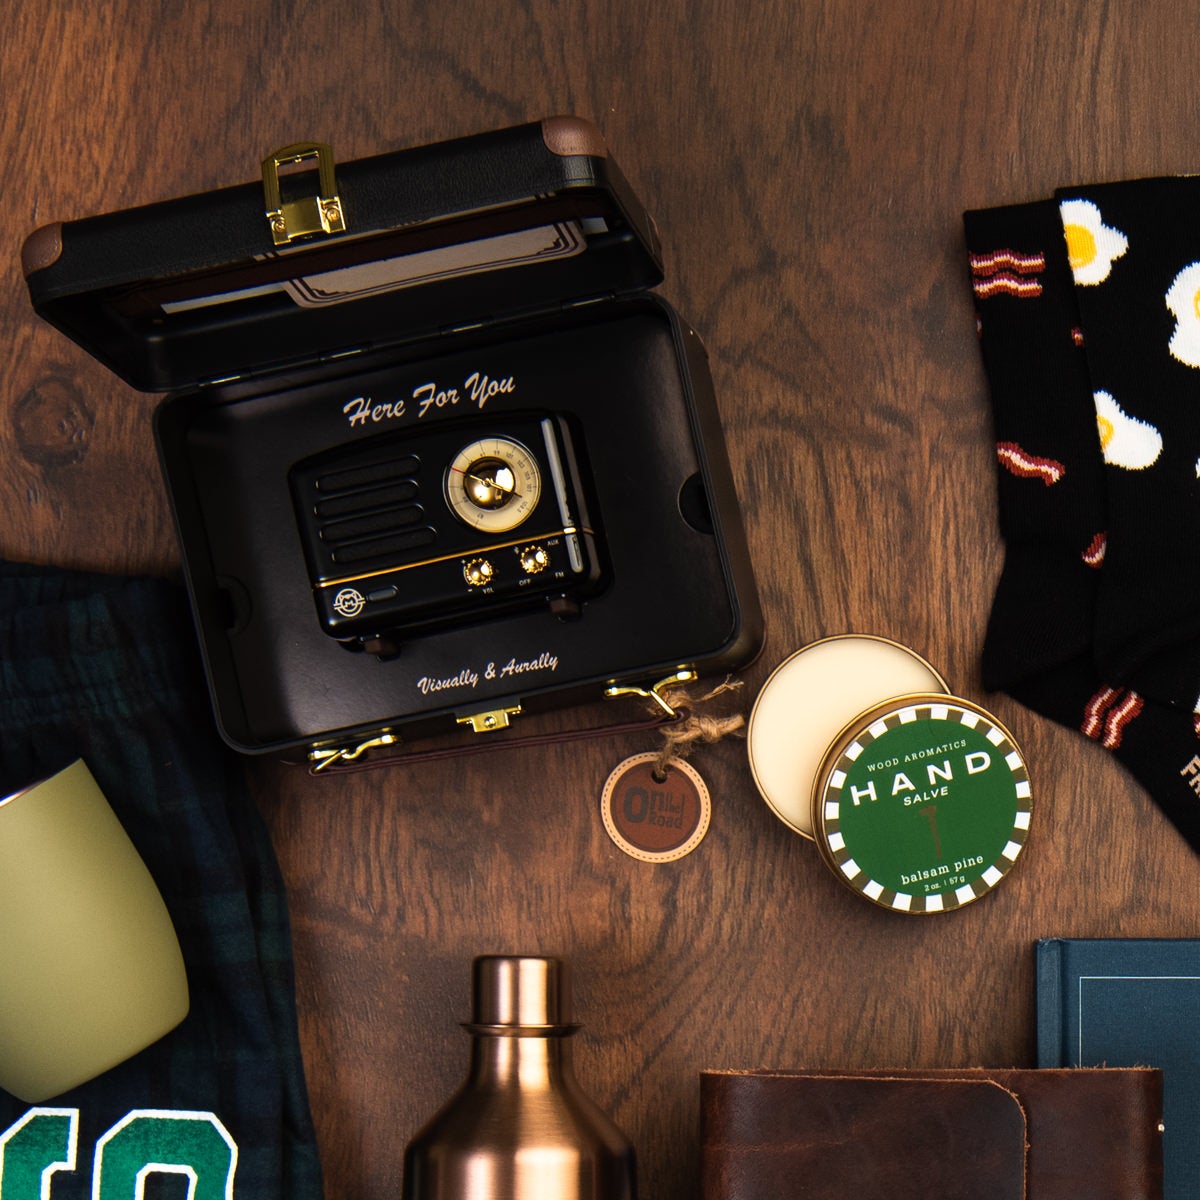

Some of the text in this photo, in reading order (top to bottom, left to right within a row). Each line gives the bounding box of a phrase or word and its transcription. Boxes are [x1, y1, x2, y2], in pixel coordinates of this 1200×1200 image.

[343, 372, 516, 427] Here For You
[417, 652, 559, 695] Visually & Aurally
[867, 739, 967, 773] WOOD AROMATICS
[850, 751, 991, 806] HAND
[903, 786, 949, 806] SALVE
[900, 855, 985, 885] balsam pine
[924, 884, 930, 892] 2
